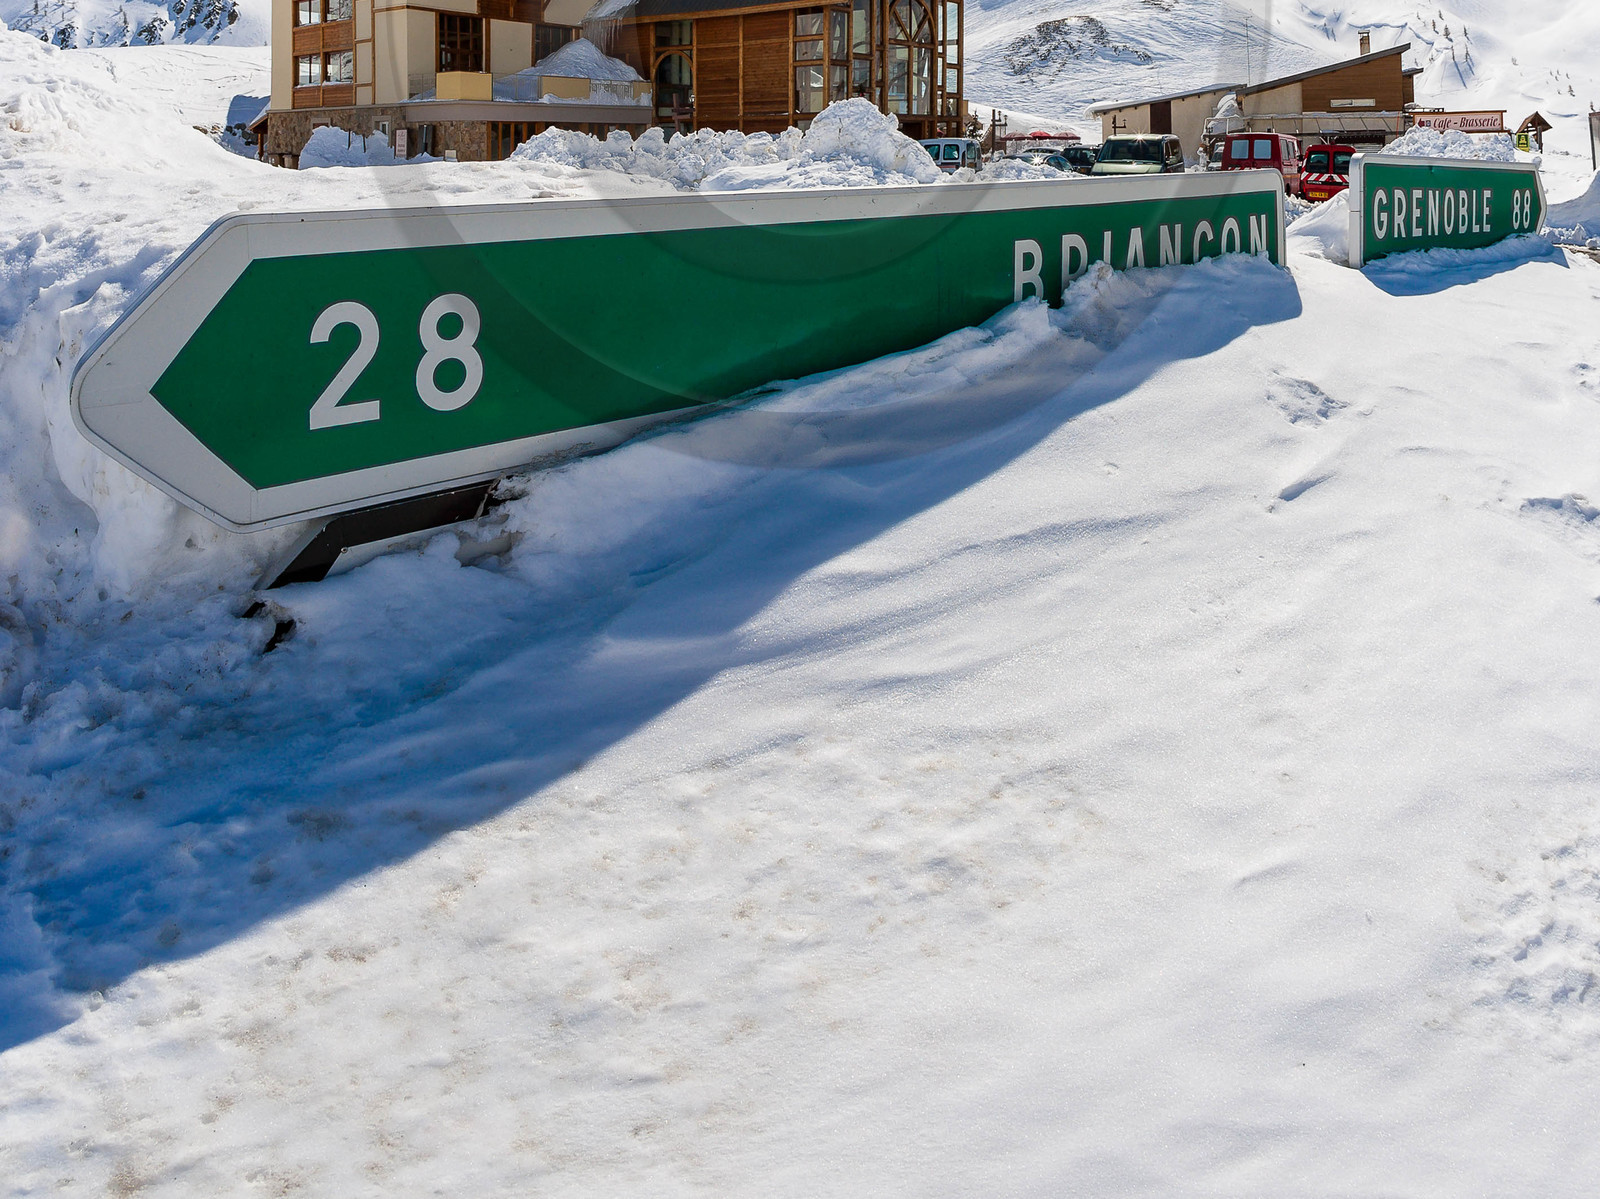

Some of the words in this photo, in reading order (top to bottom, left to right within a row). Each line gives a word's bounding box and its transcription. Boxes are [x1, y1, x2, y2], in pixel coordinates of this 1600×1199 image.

[1459, 116, 1498, 128] Brasserie
[1373, 189, 1492, 240] GRENOBLE
[1512, 189, 1532, 230] 88
[309, 293, 484, 431] 28
